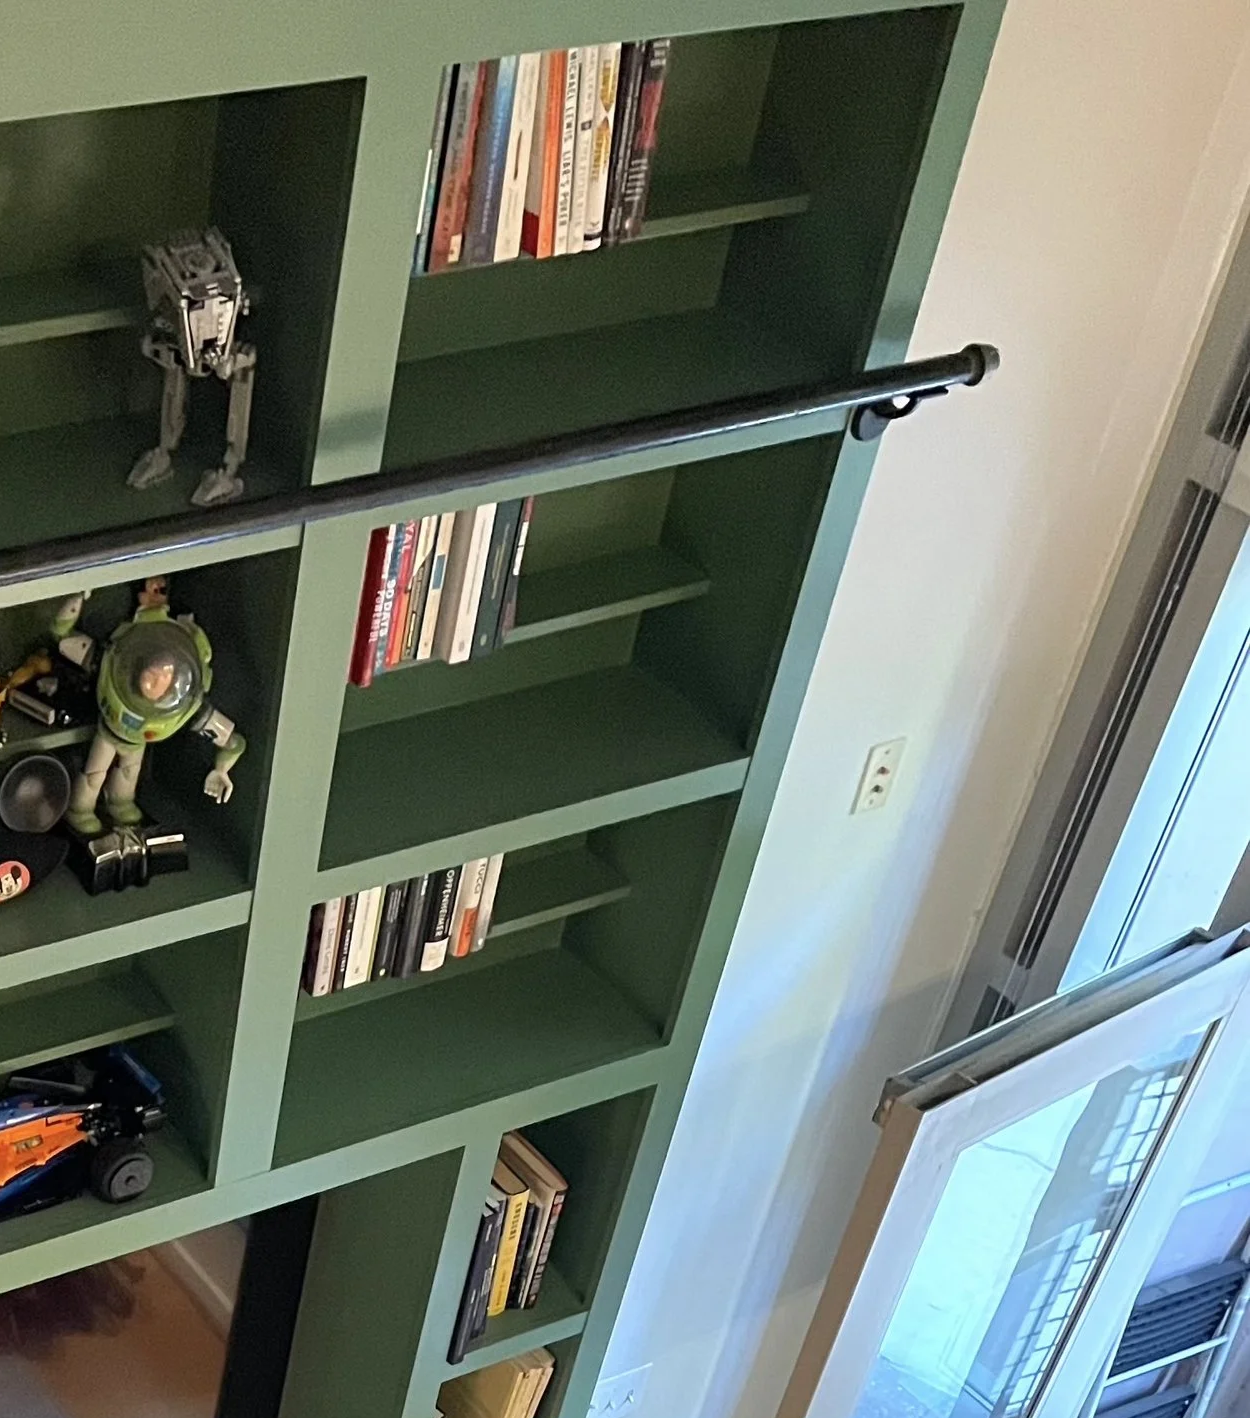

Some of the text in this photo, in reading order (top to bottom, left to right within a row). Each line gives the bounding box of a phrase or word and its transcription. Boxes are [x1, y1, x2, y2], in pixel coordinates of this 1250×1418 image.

[566, 51, 577, 100] MICHAEL
[563, 106, 573, 143] LEWIS
[558, 192, 569, 227] POKER
[385, 577, 395, 600] 90
[378, 600, 392, 637] DAYS
[433, 868, 455, 938] OPPENHEIMER
